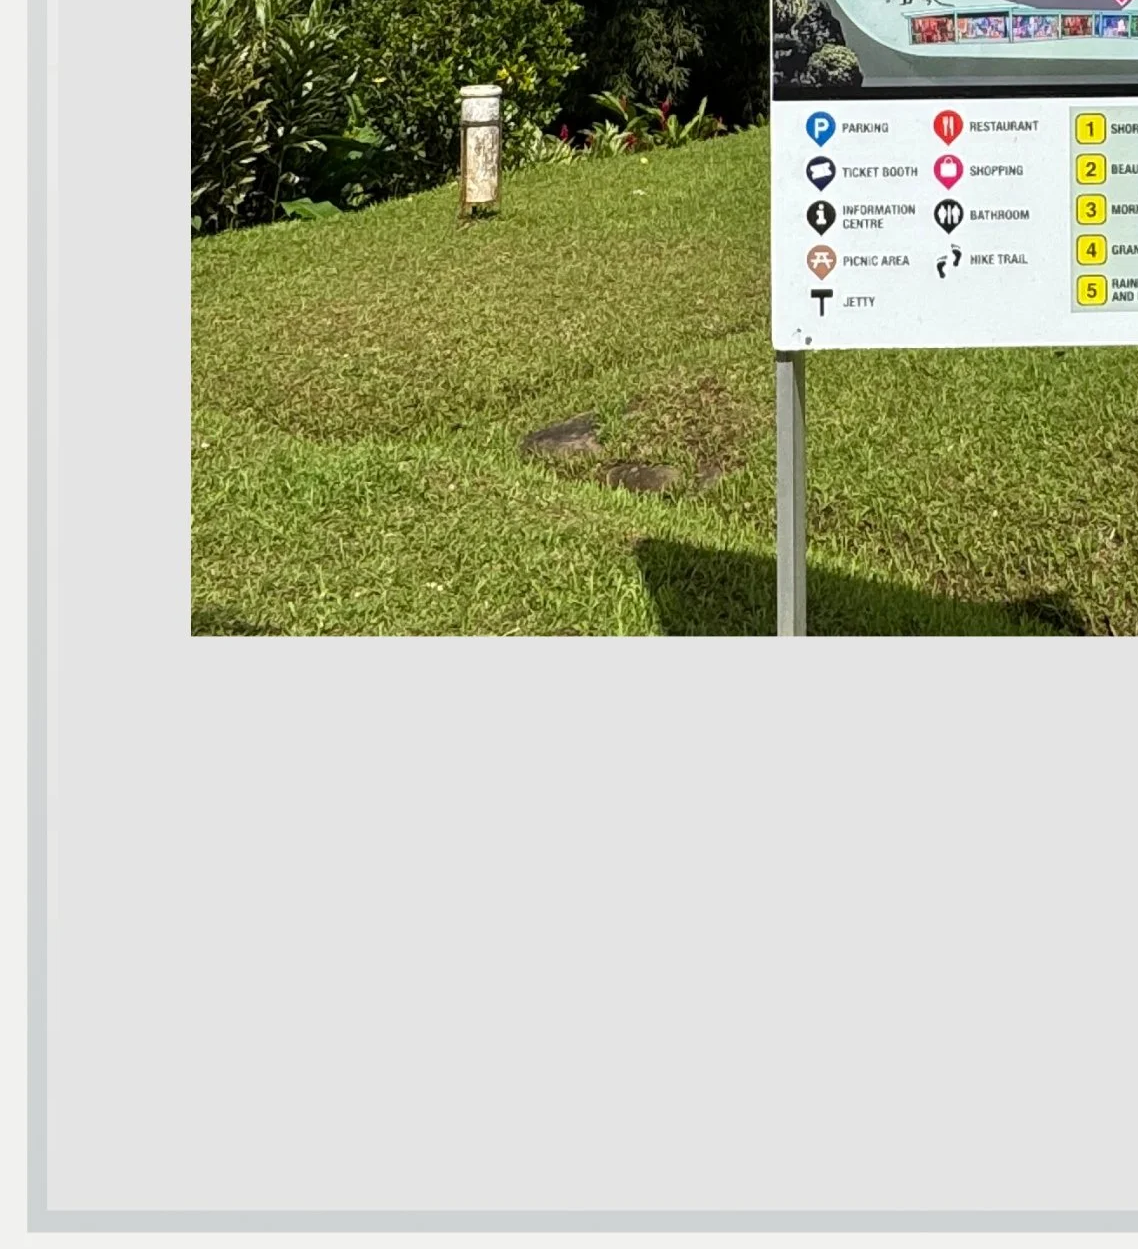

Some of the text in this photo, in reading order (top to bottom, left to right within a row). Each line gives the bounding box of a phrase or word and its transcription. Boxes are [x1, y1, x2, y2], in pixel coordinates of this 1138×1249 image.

[842, 122, 889, 133] PARKING
[969, 120, 1039, 132] RESTAURANT
[1086, 121, 1094, 137] 1
[842, 166, 918, 178] TICKET BOOTH
[969, 165, 1024, 177] SHOPPING
[1085, 162, 1097, 177] 2
[842, 204, 916, 216] INFORMATION
[970, 210, 1030, 220] BATHROOM
[1086, 202, 1097, 218] 3
[842, 218, 884, 229] CENTRE
[1086, 243, 1097, 258] 4
[843, 255, 910, 266] PICNIC AREA
[970, 254, 1028, 265] HIKE TRAIL
[1086, 283, 1097, 298] 5
[1112, 290, 1134, 301] AND
[843, 296, 875, 307] JETTY
